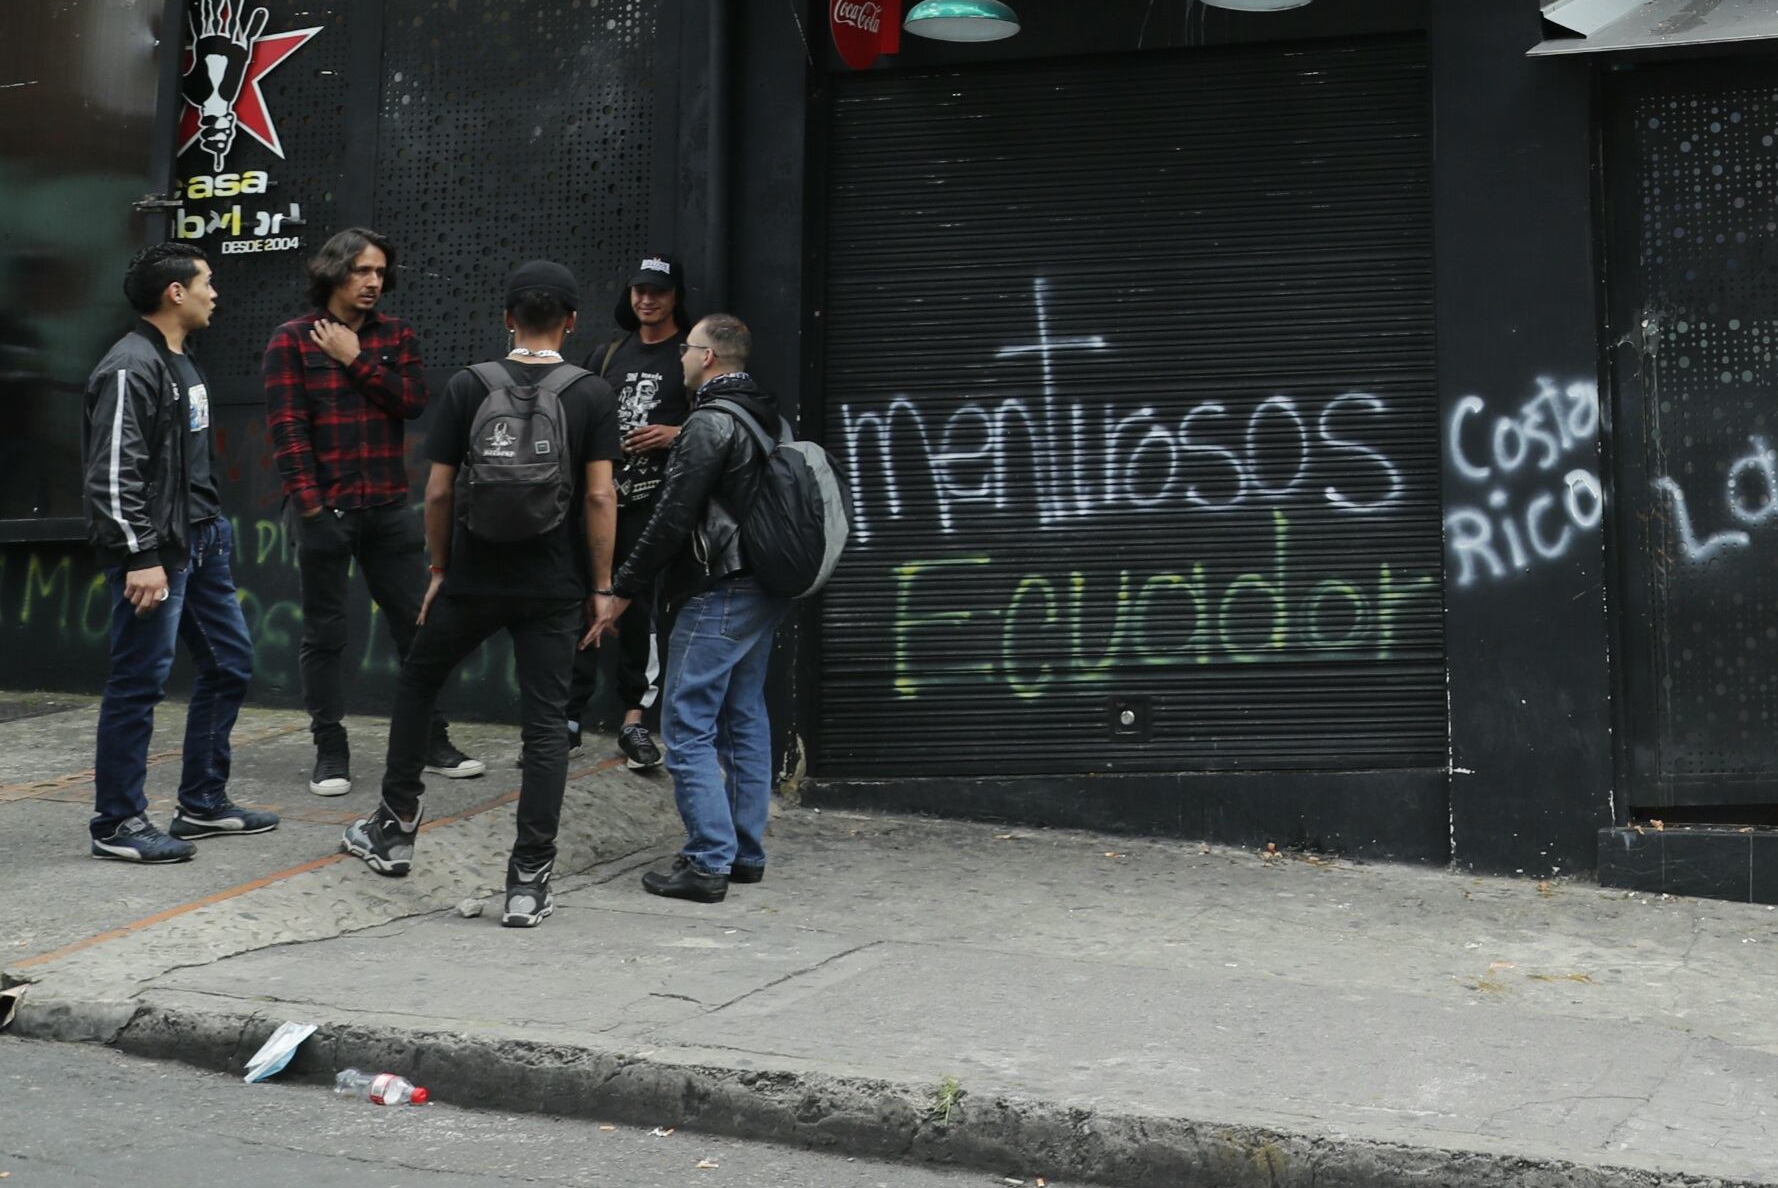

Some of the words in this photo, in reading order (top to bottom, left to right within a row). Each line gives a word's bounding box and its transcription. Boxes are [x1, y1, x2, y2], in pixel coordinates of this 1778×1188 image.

[174, 170, 269, 200] asa
[222, 239, 264, 255] DESDE
[264, 236, 299, 252] 2004
